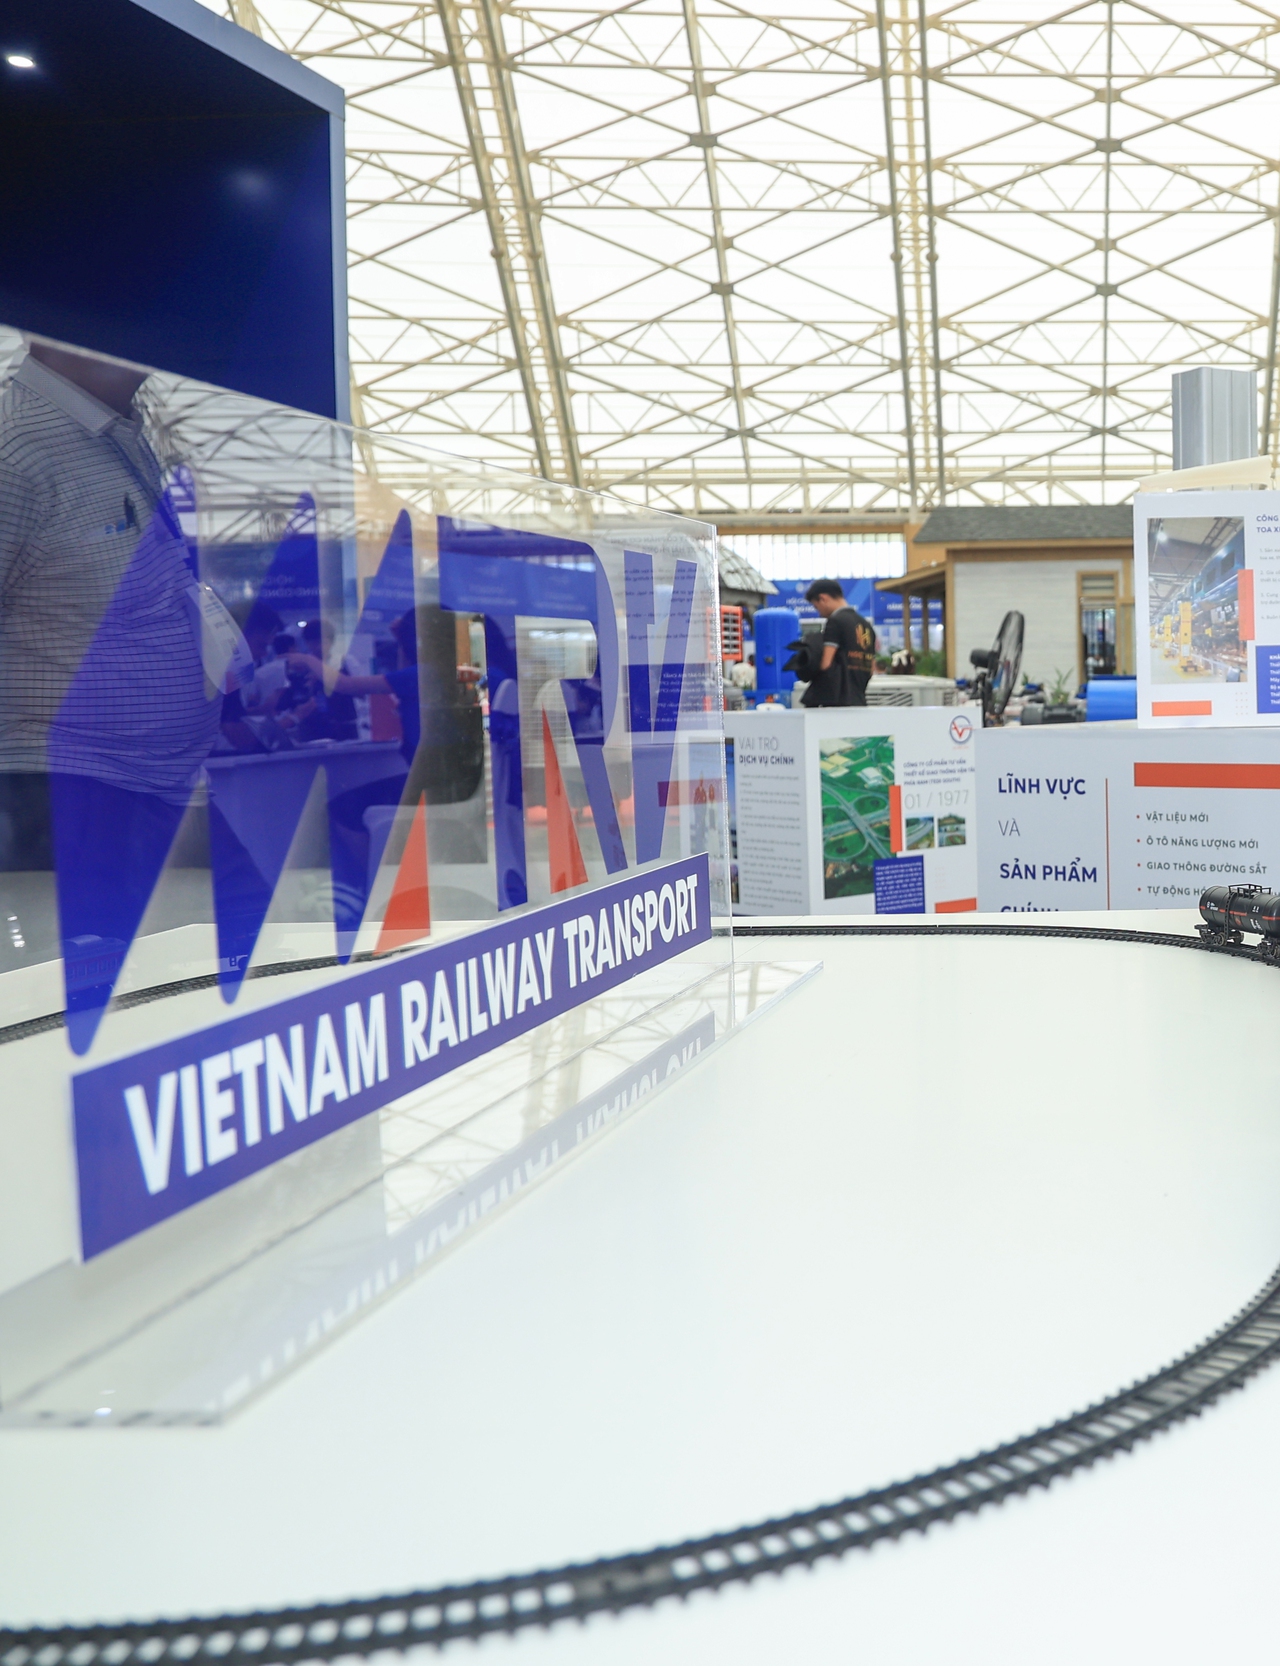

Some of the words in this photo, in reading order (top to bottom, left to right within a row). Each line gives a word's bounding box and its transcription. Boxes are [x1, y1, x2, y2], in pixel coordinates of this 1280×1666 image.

[1256, 514, 1278, 522] CÔNG
[739, 737, 754, 750] VAI
[758, 736, 779, 751] TRÒ
[739, 755, 756, 767] DỊCH
[758, 755, 768, 767] VỤ
[770, 753, 794, 765] CHÍNH
[998, 773, 1040, 794] LĨNH
[1045, 777, 1086, 800] VỰC
[904, 792, 921, 810] 01
[938, 790, 969, 806] 1977
[1146, 811, 1163, 823] VẬT
[1166, 811, 1186, 824] LIỆU
[1189, 812, 1209, 822] MỚI
[998, 818, 1020, 836] VÀ
[1146, 835, 1153, 845] Ô
[1156, 836, 1168, 846] TÔ
[1171, 836, 1198, 847] NĂNG
[1201, 838, 1236, 850] LƯỢNG
[1239, 838, 1259, 849] MỚI
[1000, 858, 1036, 880] SẢN
[1042, 857, 1097, 882] PHẨM
[1147, 862, 1170, 870] GIAO
[1173, 861, 1207, 872] THÔNG
[1209, 863, 1246, 874] ĐƯỜNG
[1249, 862, 1267, 874] SẮT
[1147, 886, 1160, 897] TỰ
[1163, 885, 1190, 897] ĐỘNG
[124, 992, 389, 1195] VIETNAM
[400, 927, 555, 1069] RAILWAY
[563, 873, 698, 988] TRANSPORT
